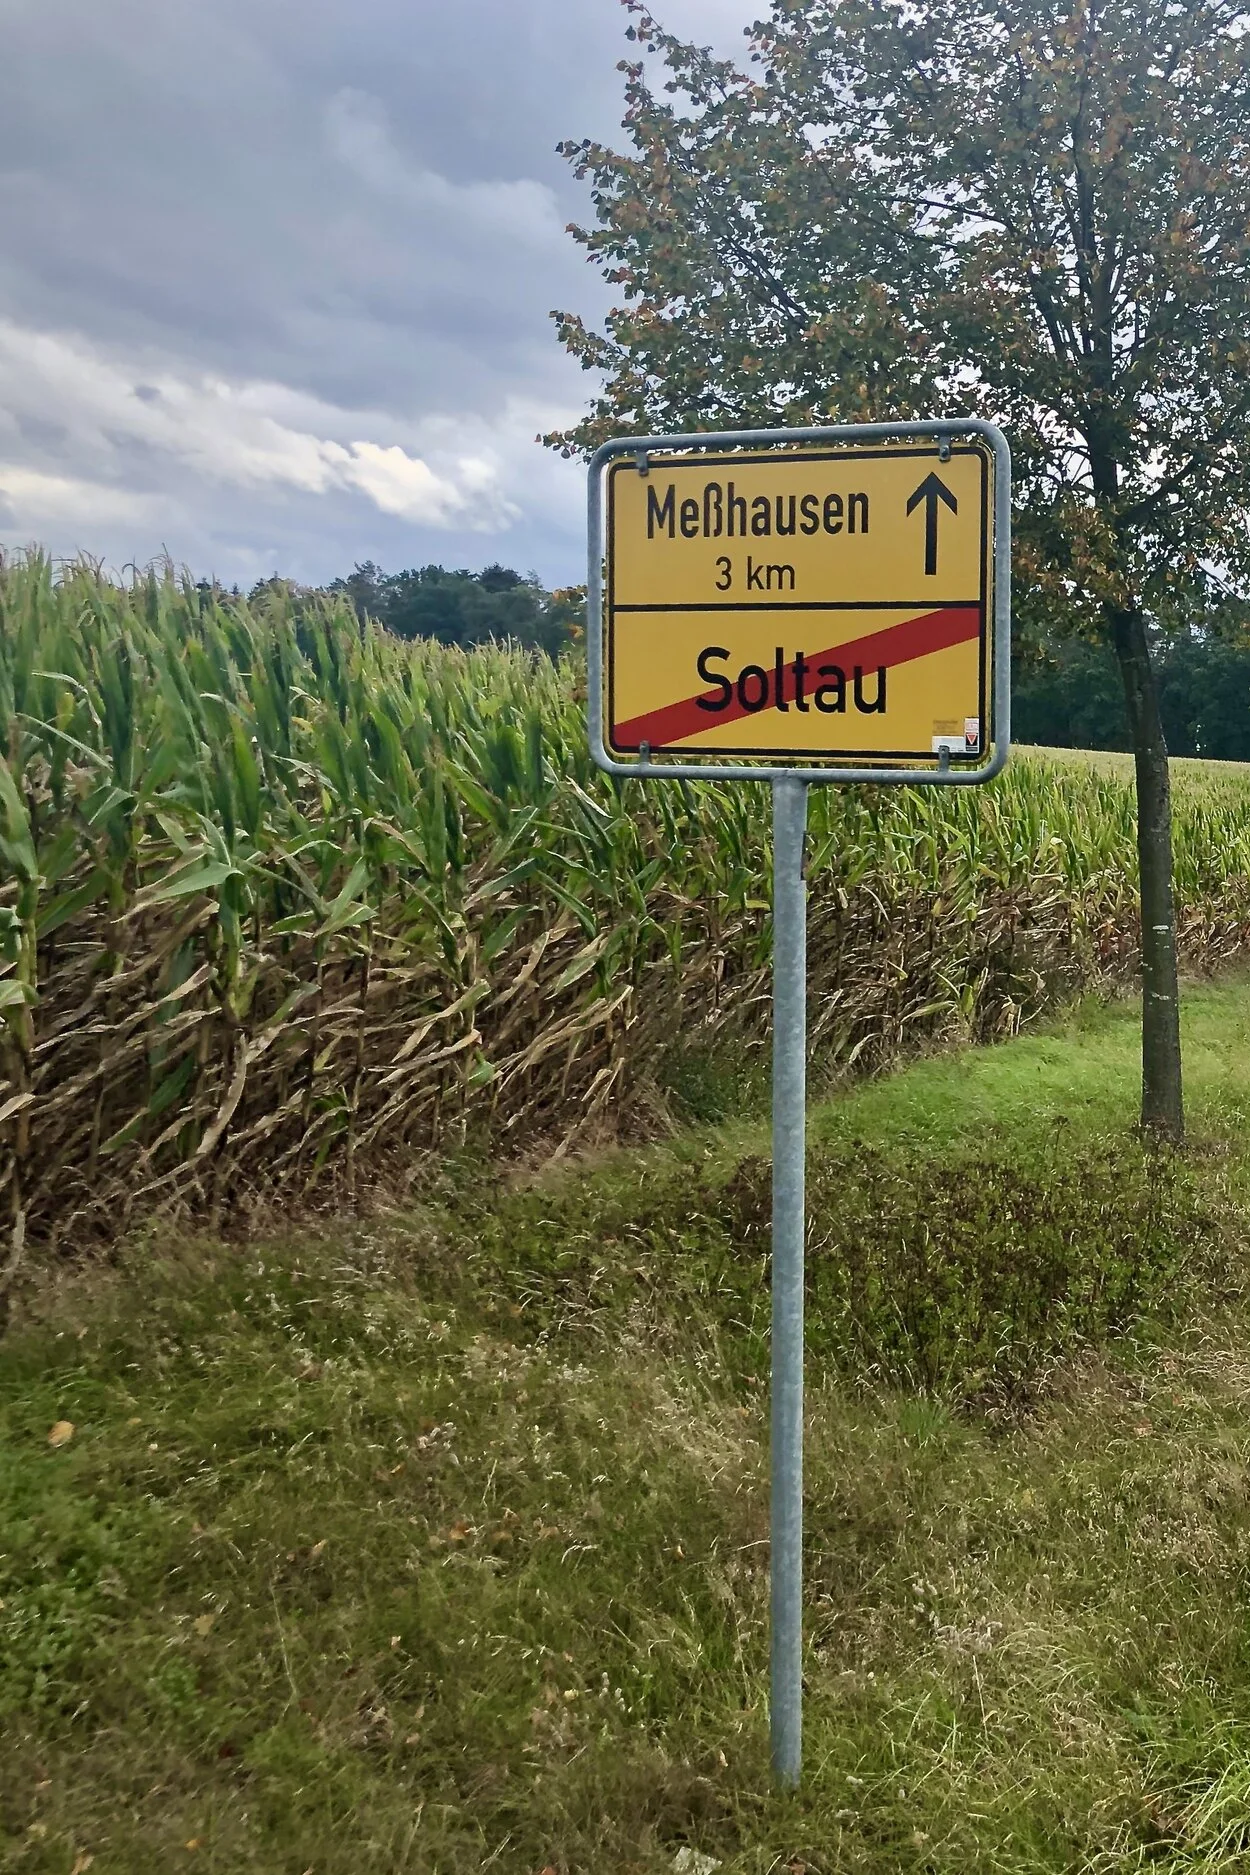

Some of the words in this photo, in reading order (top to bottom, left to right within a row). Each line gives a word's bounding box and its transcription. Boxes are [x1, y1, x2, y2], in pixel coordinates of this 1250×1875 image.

[647, 482, 869, 538] Meßhausen
[715, 556, 732, 590] 3
[747, 556, 796, 590] km
[696, 646, 887, 714] Soltau
